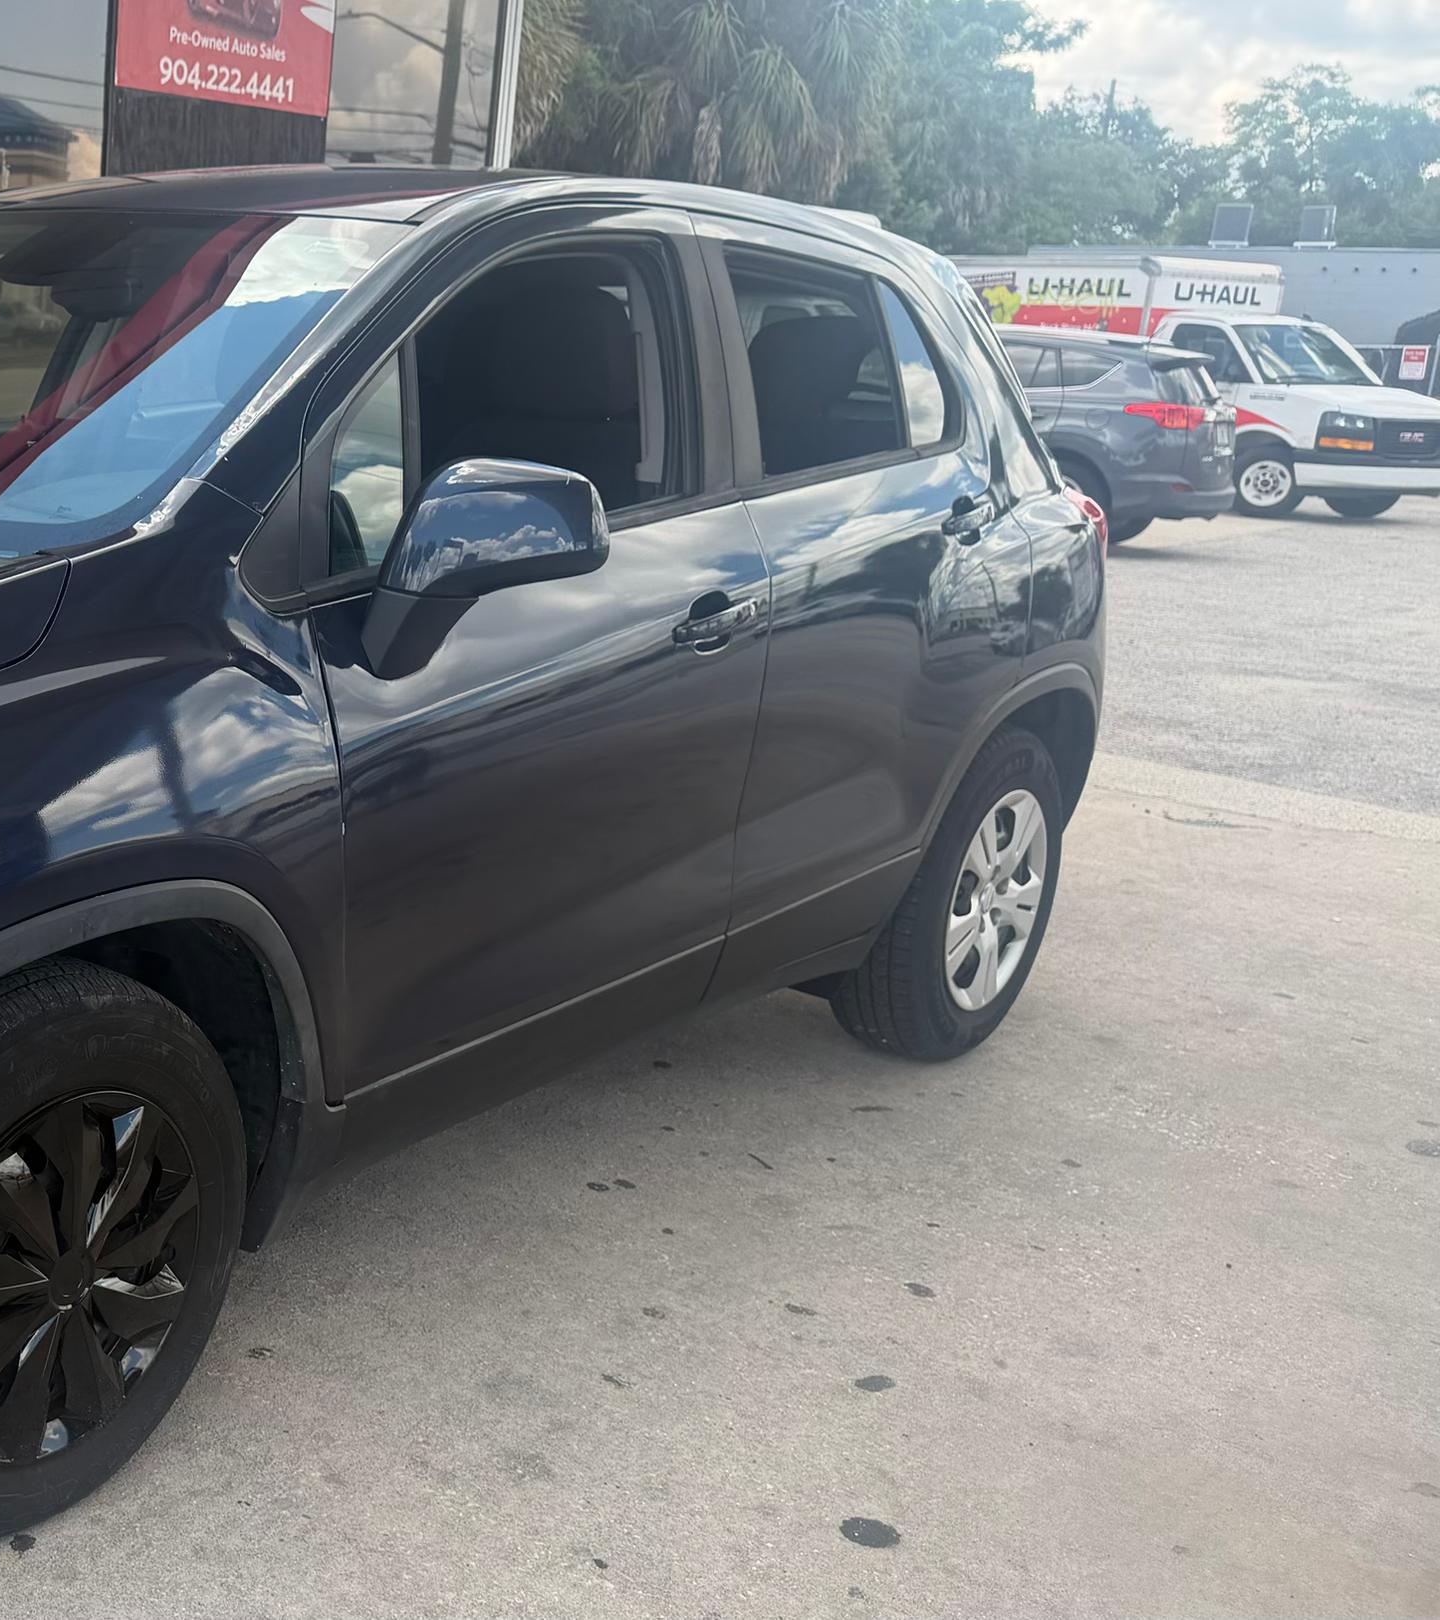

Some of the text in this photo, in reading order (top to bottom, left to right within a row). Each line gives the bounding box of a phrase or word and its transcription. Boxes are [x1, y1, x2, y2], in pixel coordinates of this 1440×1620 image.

[170, 26, 286, 62] Pre-Owned Auto Sales
[160, 56, 295, 104] 904.222.4441
[1028, 277, 1132, 298] U-HAUL
[1174, 281, 1261, 306] U-HAUL
